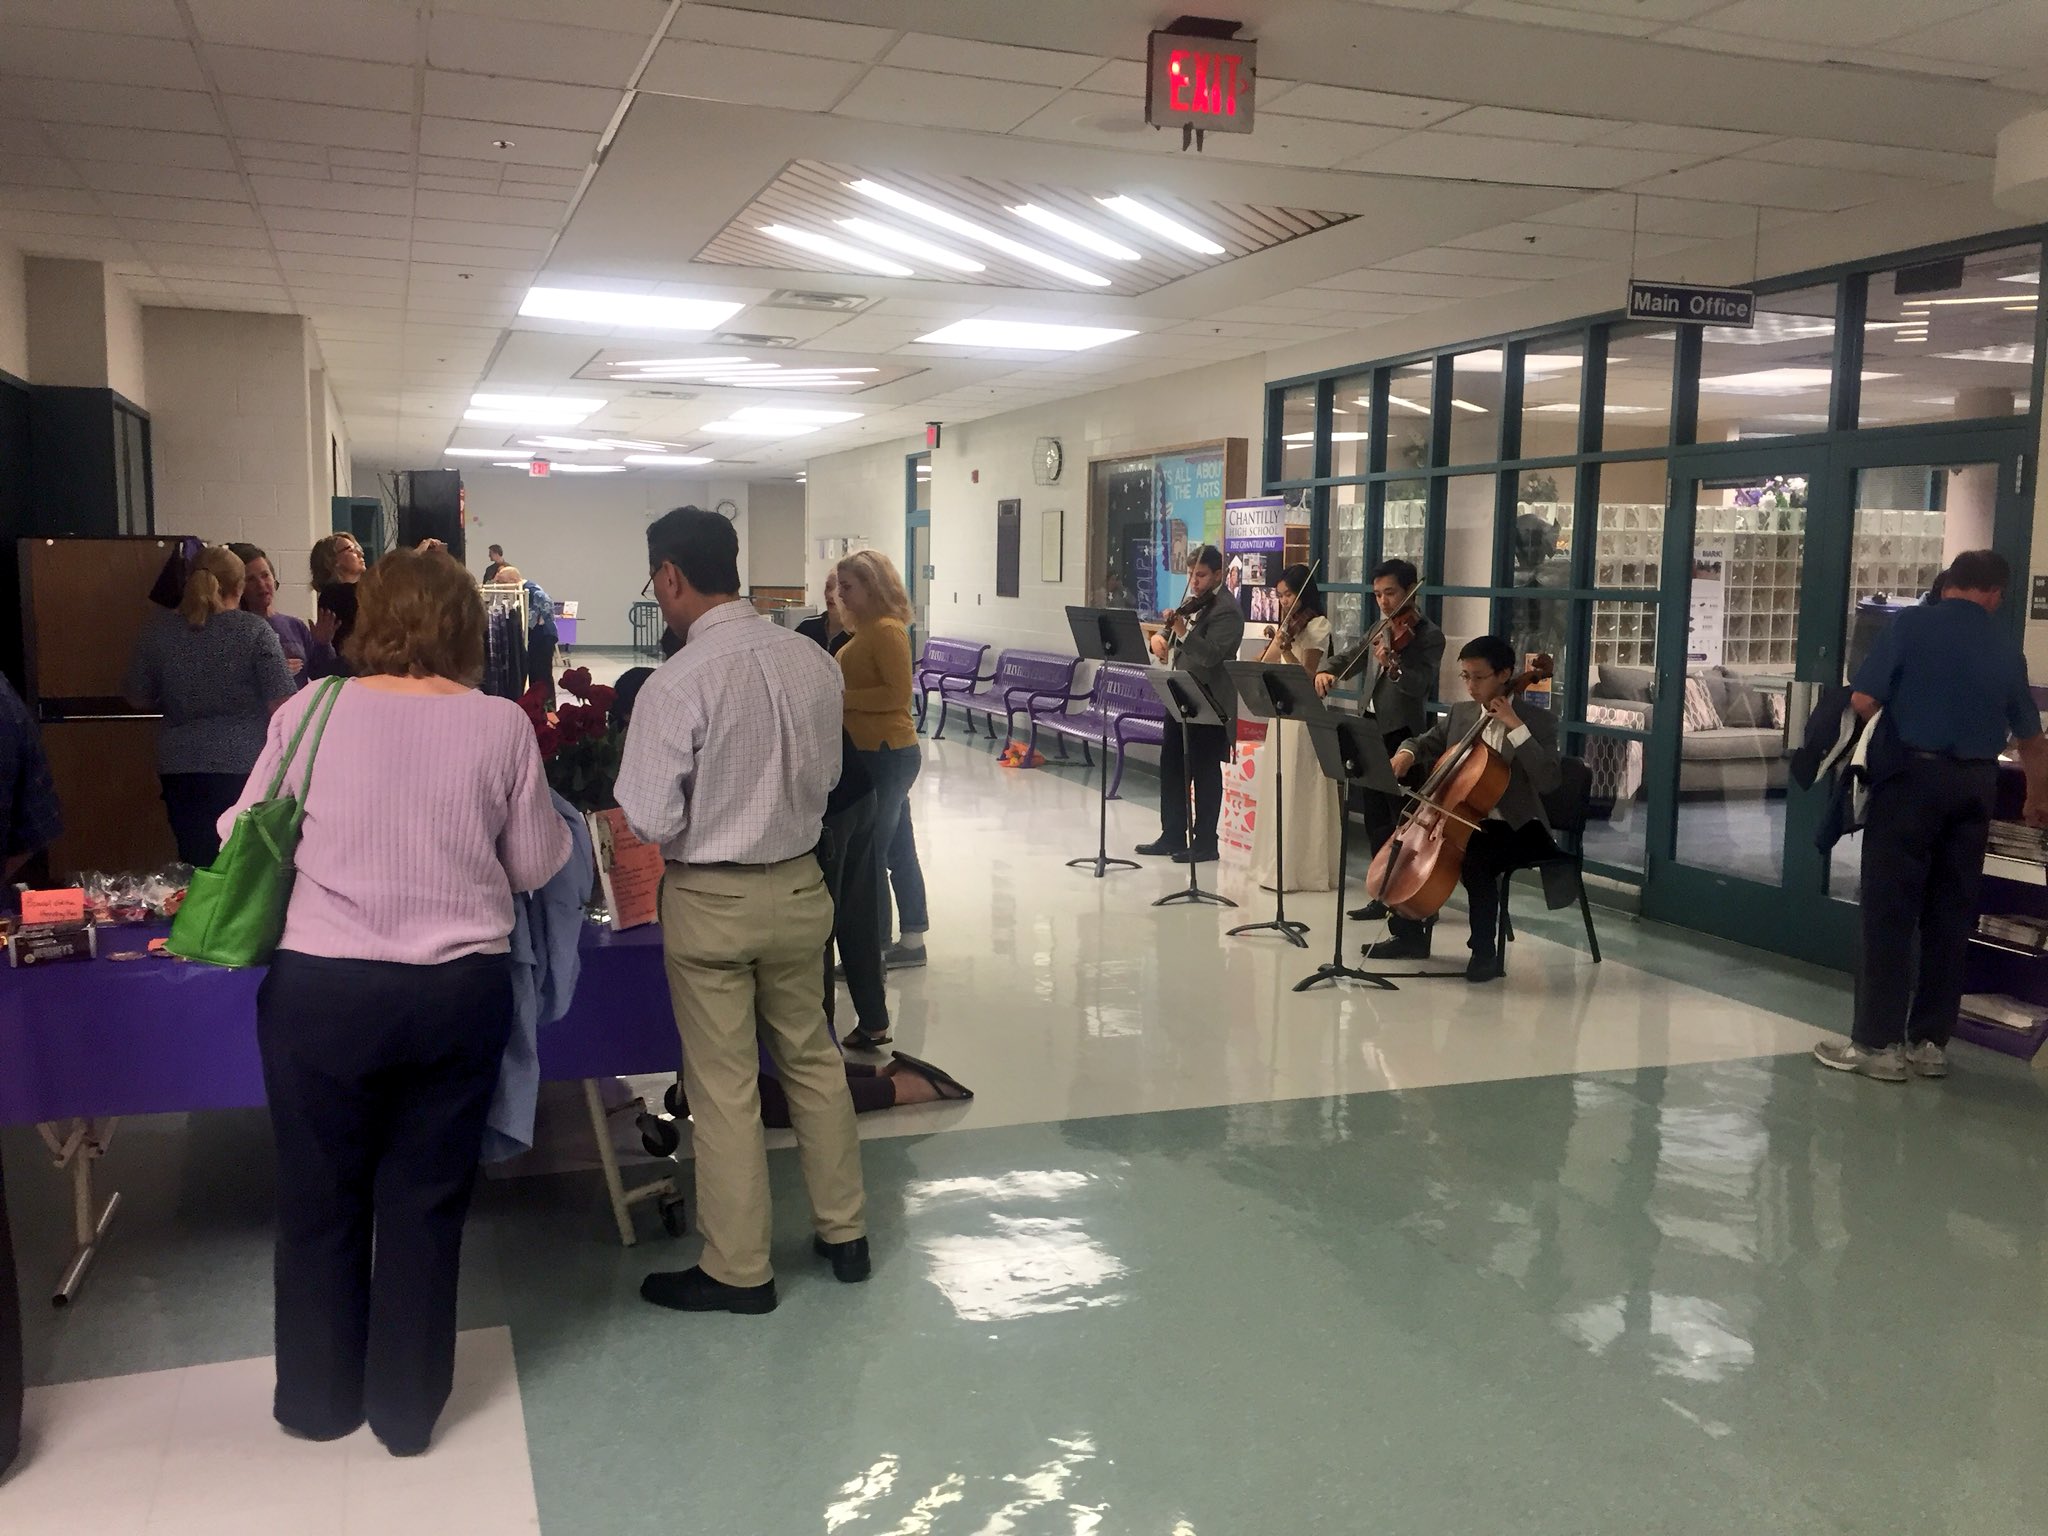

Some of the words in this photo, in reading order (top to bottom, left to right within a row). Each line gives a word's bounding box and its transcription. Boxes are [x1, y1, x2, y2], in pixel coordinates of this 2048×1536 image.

[1169, 49, 1243, 117] EXIT
[1633, 291, 1680, 313] Main
[1689, 295, 1749, 318] Office
[1174, 467, 1192, 484] ALL
[1196, 462, 1222, 479] ABOU
[1173, 483, 1192, 501] THE
[1195, 480, 1221, 499] ARTS
[1229, 509, 1280, 526] CHANTILLY
[1229, 527, 1248, 538] HIGH
[1249, 525, 1280, 537] SCHOOL
